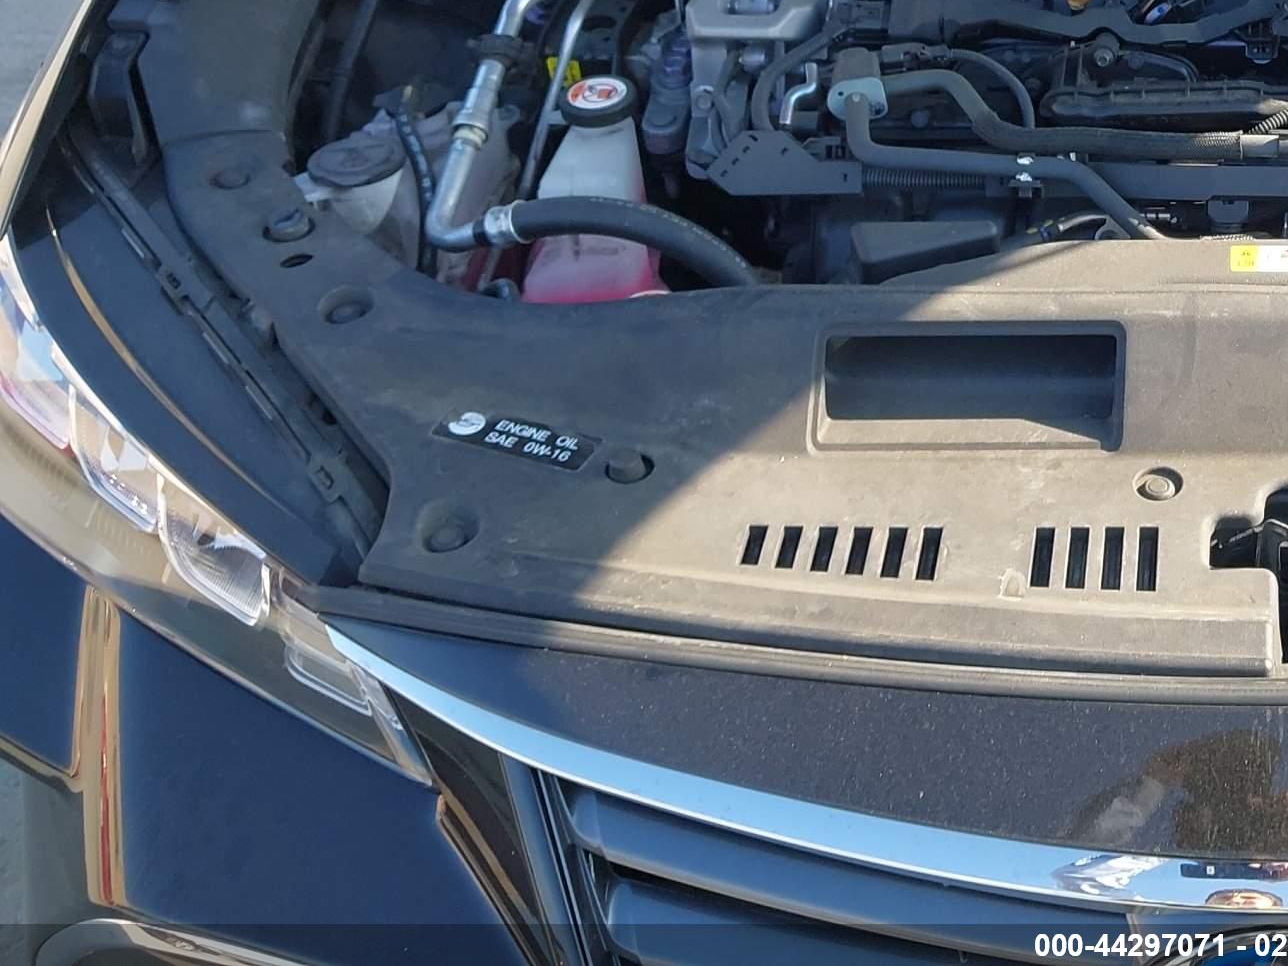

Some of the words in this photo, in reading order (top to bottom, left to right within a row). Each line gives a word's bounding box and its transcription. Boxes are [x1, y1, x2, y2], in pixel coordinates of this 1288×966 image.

[484, 431, 520, 449] SAE
[522, 441, 572, 462] 0W-16
[494, 419, 552, 443] ENGINE
[555, 435, 579, 451] OIL
